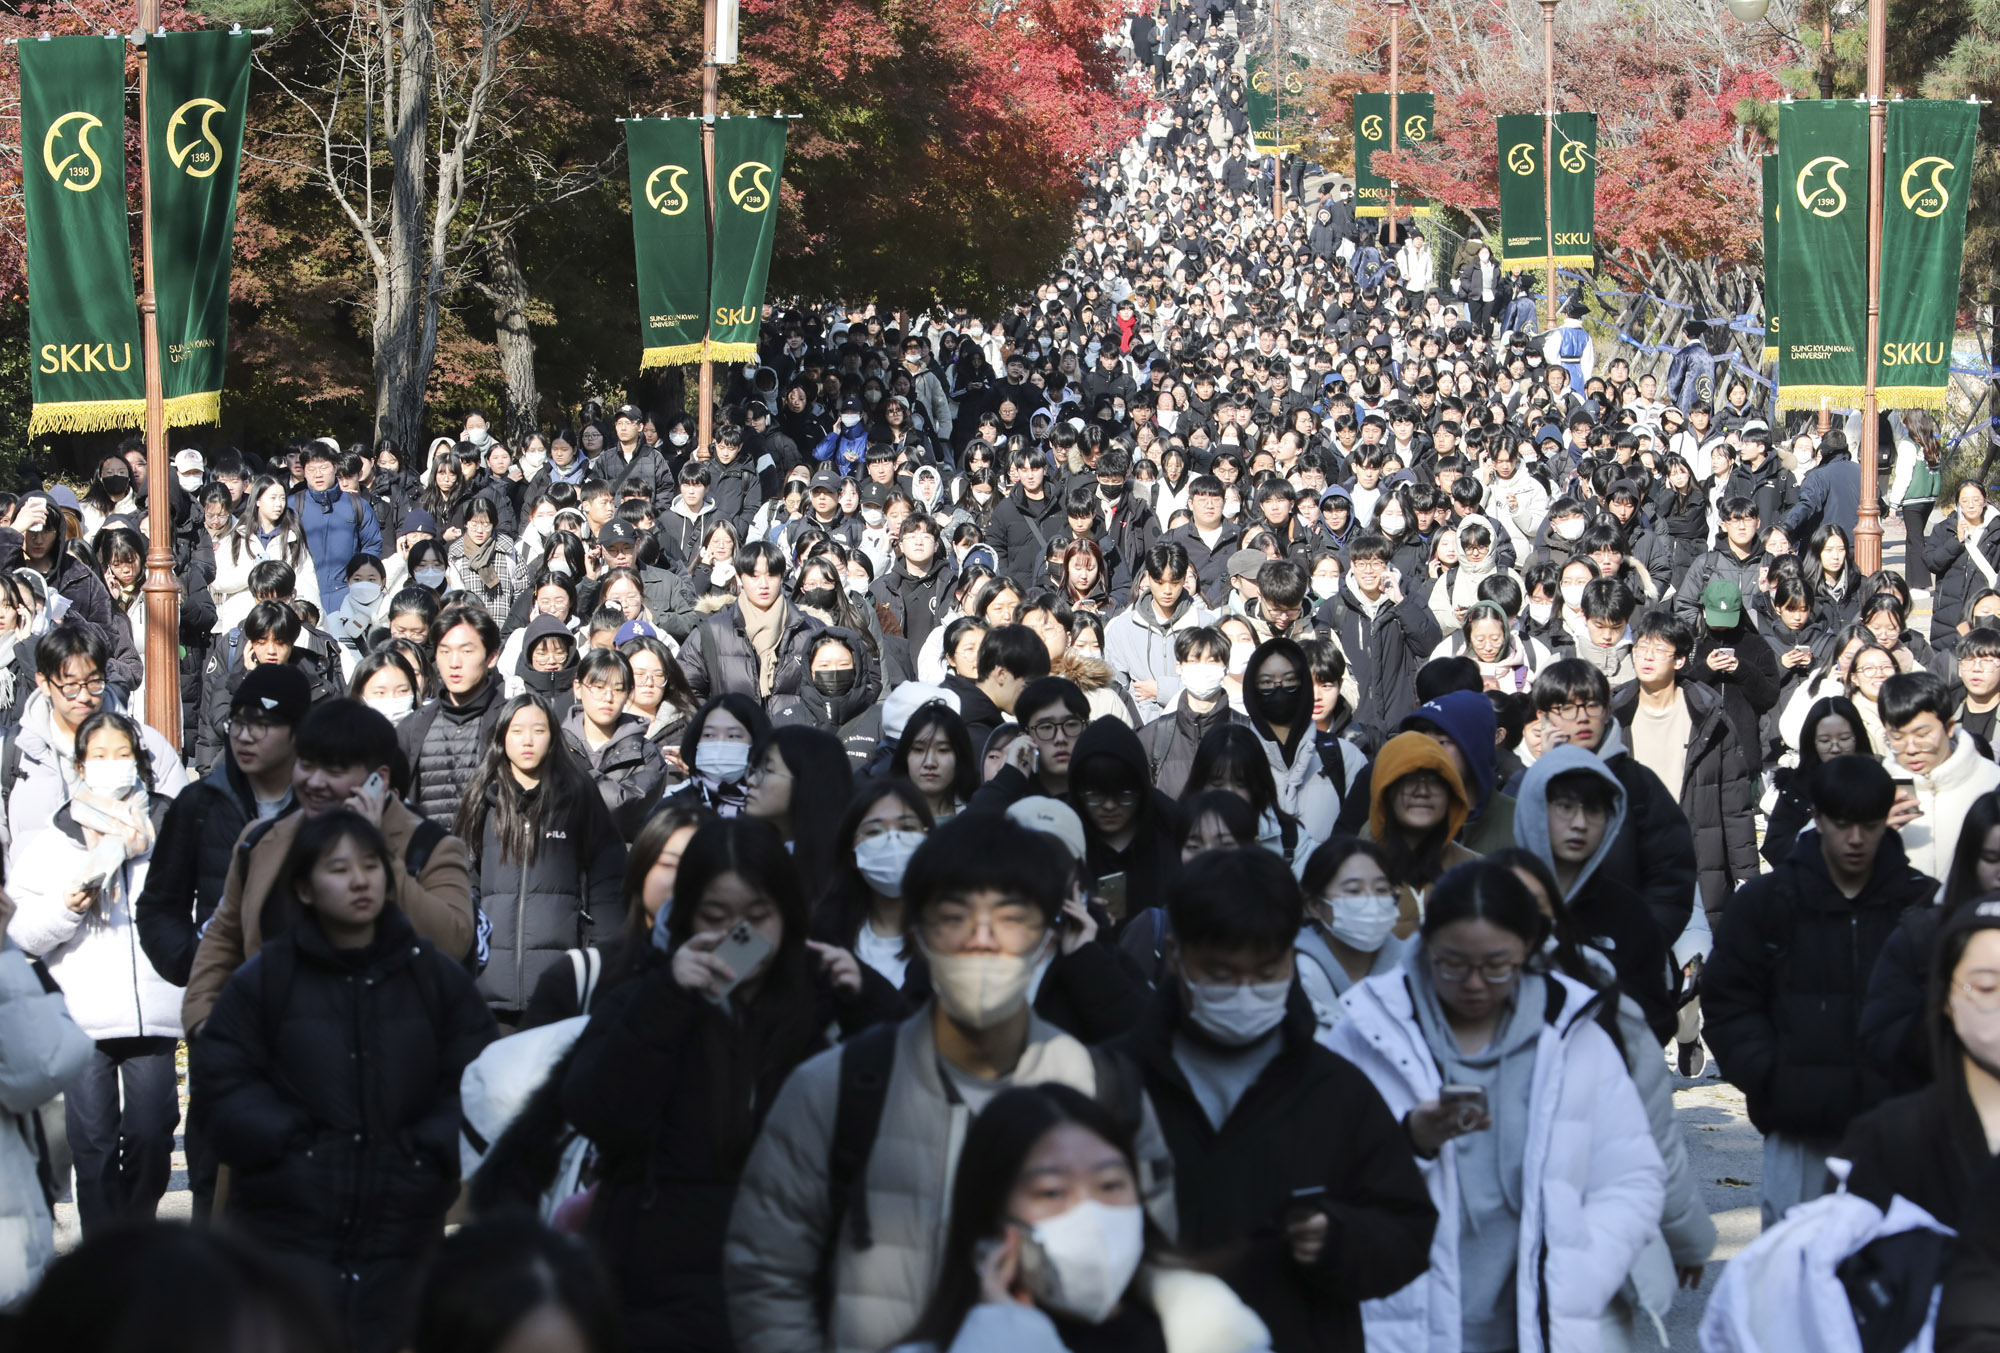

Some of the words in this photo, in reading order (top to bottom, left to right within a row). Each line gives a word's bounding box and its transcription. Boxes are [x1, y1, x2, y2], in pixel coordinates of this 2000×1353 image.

[191, 153, 210, 163] 1398
[69, 167, 90, 177] 1398
[664, 199, 679, 207] 1398
[746, 196, 762, 204] 1398
[1817, 198, 1835, 206] 1398
[1920, 198, 1938, 206] 1398
[1554, 232, 1591, 246] SKKU
[40, 343, 131, 374] SKKU
[1791, 352, 1832, 360] UNIVERSITY
[1882, 342, 1945, 366] SKKU
[545, 830, 567, 839] FILA
